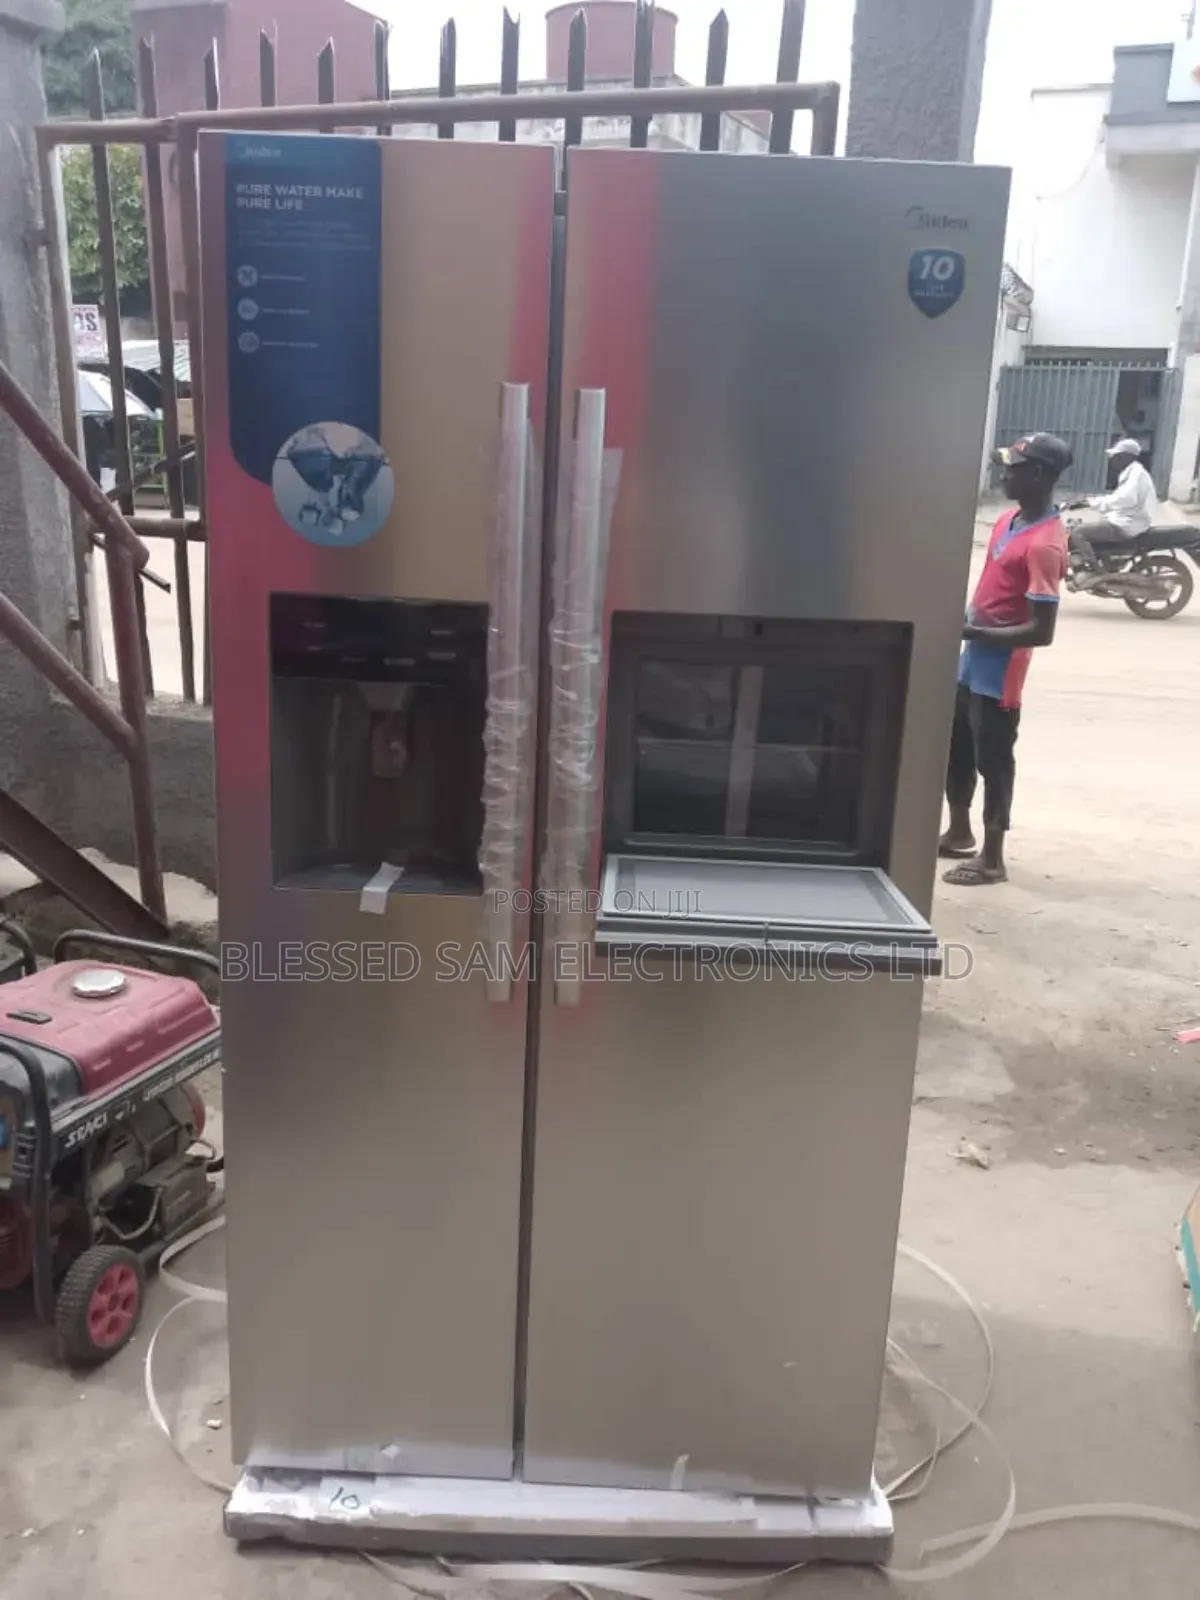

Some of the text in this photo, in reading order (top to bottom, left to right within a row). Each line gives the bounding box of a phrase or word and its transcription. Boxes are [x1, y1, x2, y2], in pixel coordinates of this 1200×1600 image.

[236, 184, 364, 199] PURE WATER MAKE
[236, 197, 303, 210] PURE LIFE
[920, 255, 956, 281] 10
